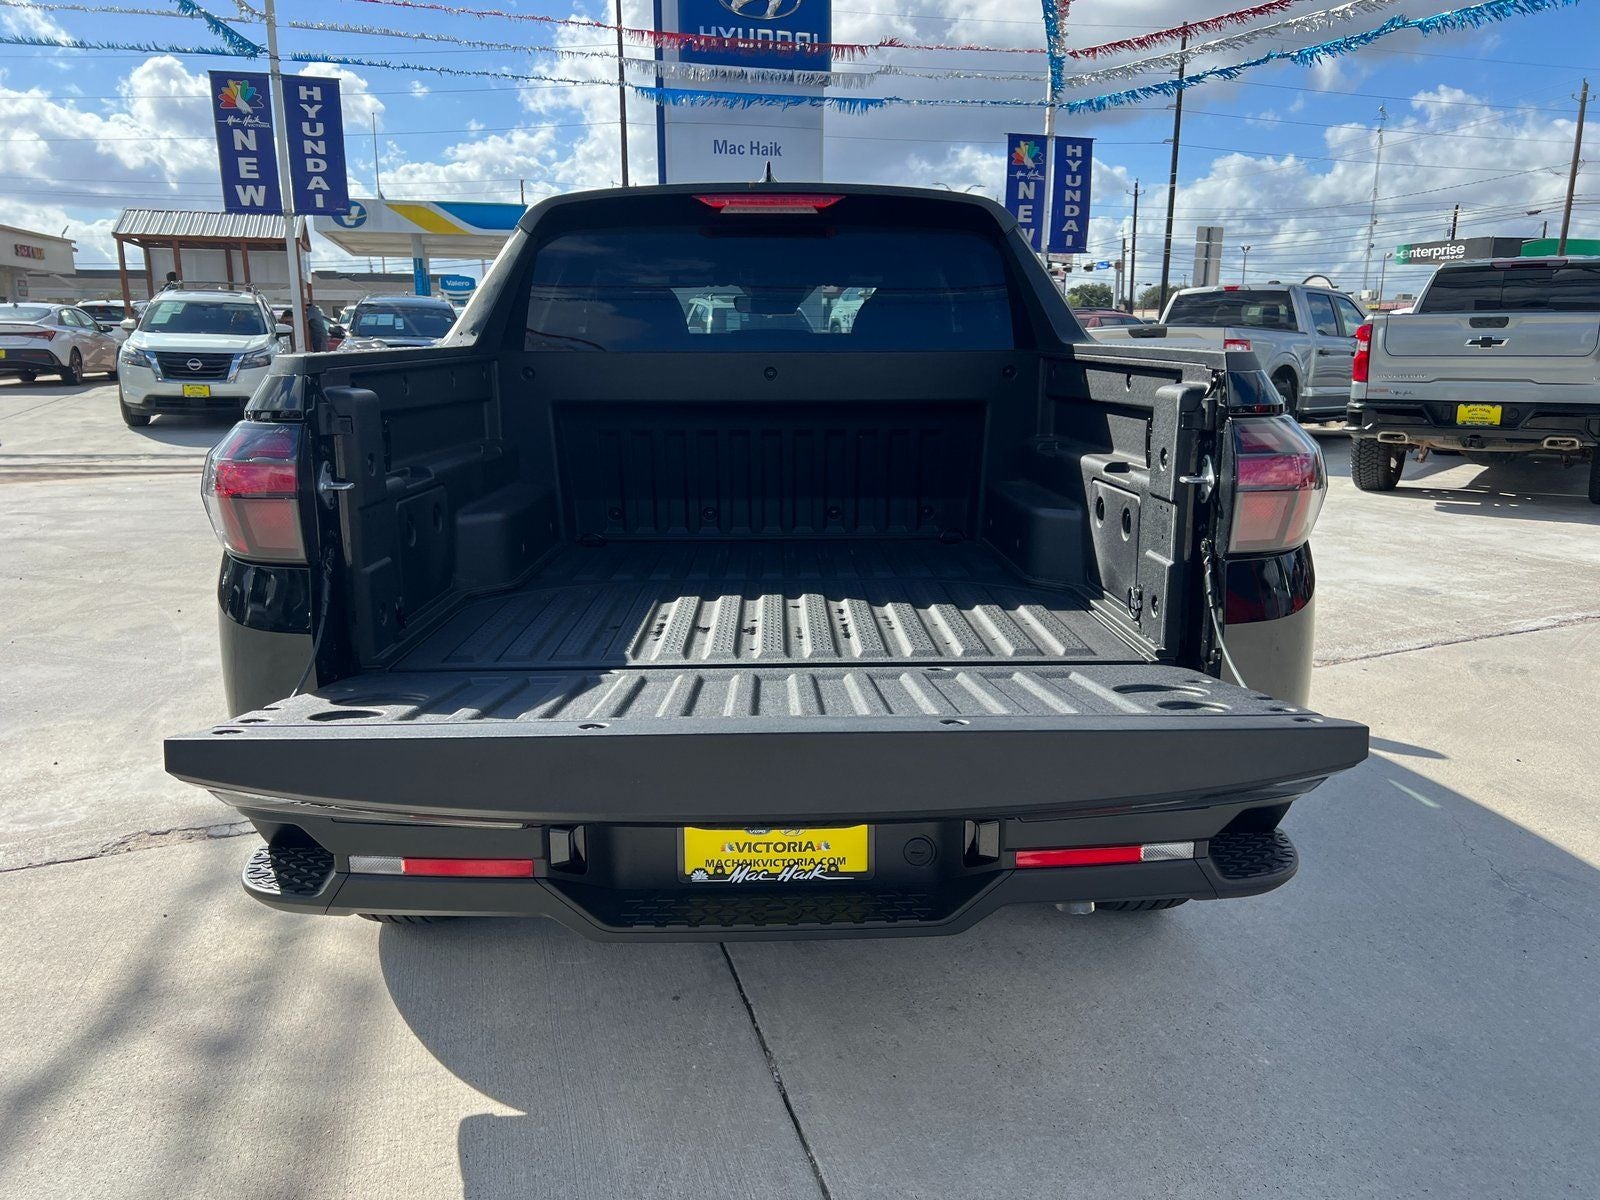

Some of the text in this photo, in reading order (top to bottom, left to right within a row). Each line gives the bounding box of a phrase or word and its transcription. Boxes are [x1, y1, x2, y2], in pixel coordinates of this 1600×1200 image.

[298, 85, 331, 208] HYUNDAI
[713, 139, 782, 157] Mac Haik
[232, 129, 266, 207] NEW
[1061, 144, 1083, 247] HYUNDAI
[1397, 243, 1465, 260] enterprise
[446, 279, 470, 287] Valero
[735, 841, 817, 854] VICTORIA
[728, 863, 828, 884] Mac Haik
